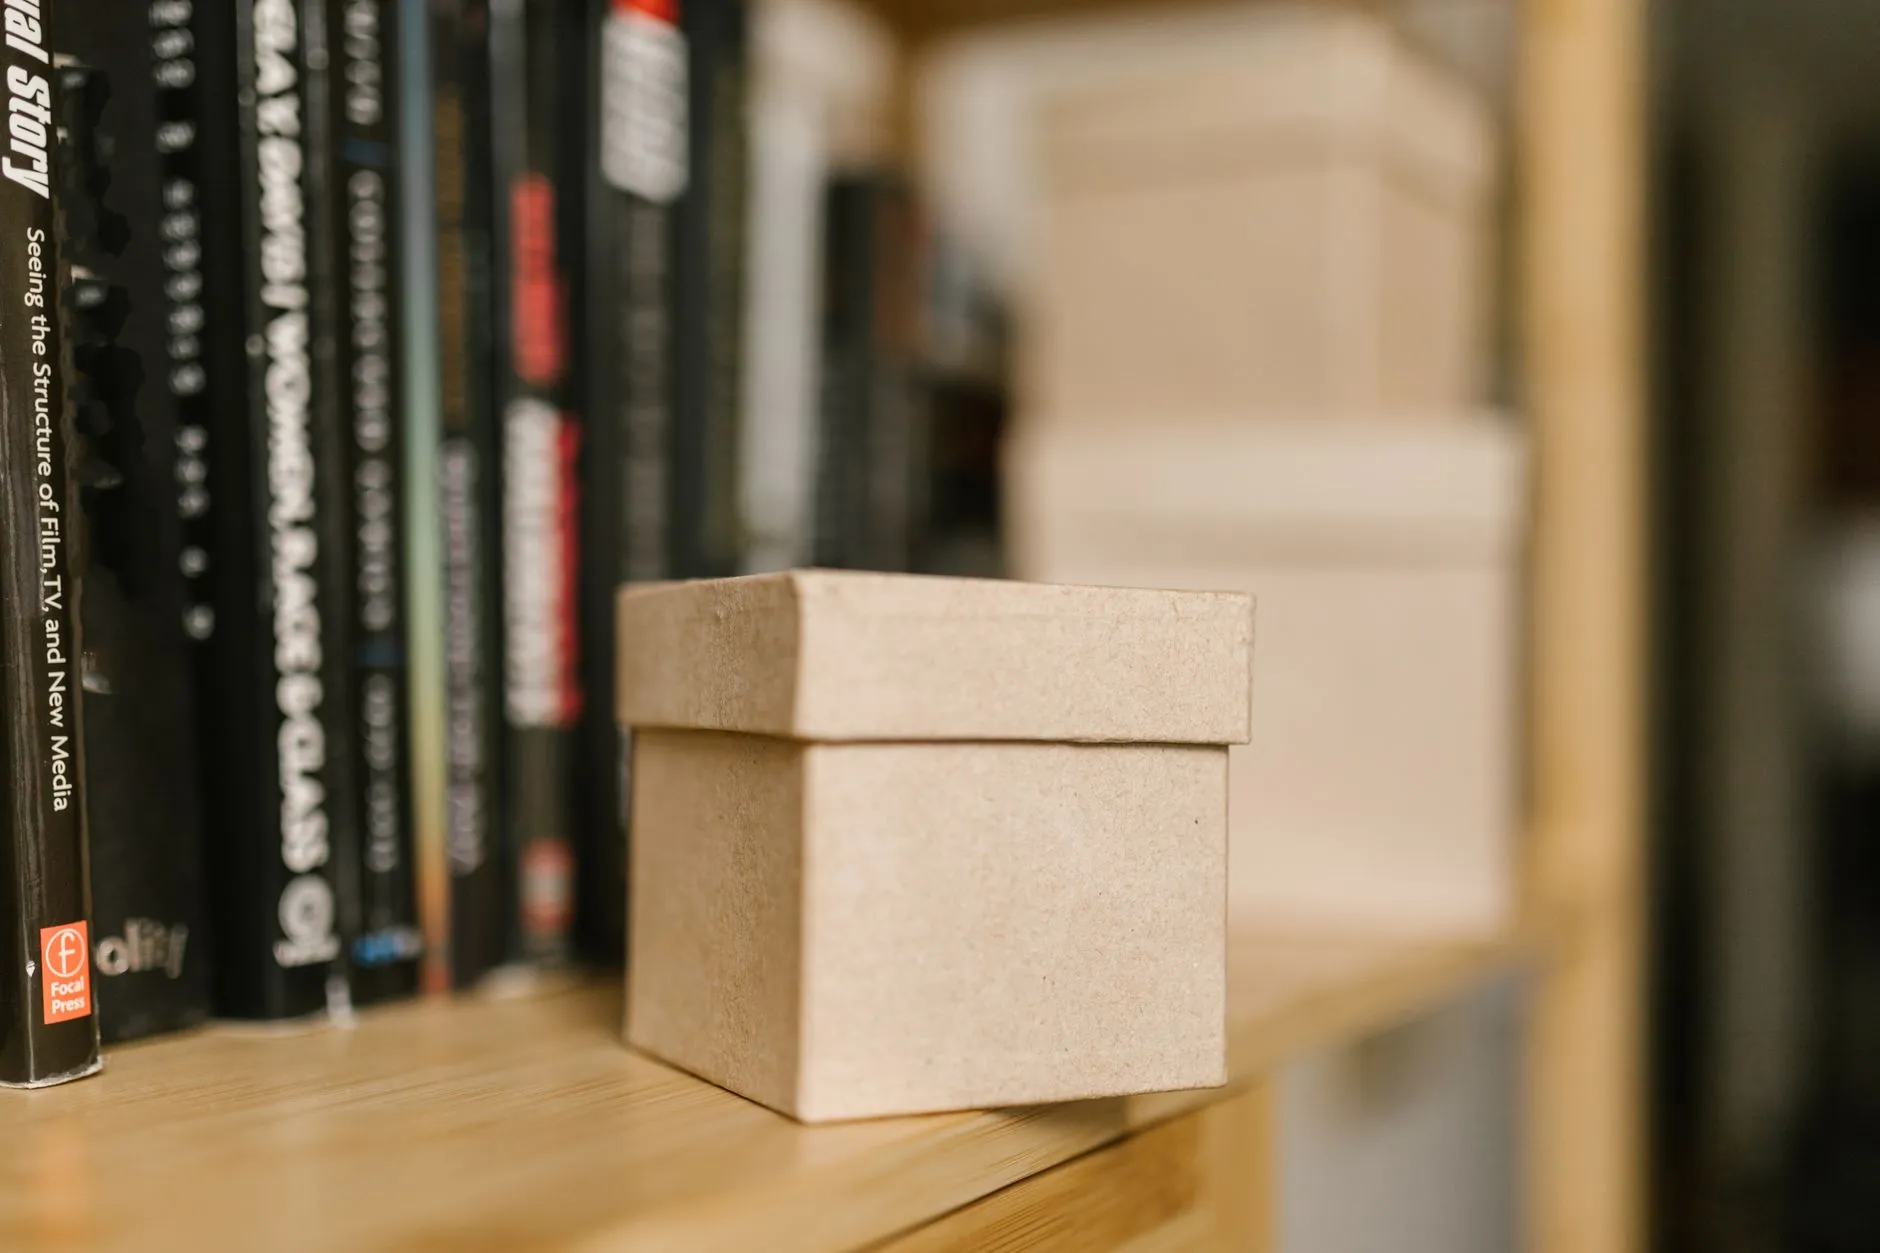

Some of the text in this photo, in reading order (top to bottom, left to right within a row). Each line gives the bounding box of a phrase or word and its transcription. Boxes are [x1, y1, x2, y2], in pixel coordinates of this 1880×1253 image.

[2, 66, 52, 199] Story
[24, 227, 47, 308] Seeing
[30, 314, 51, 356] the
[32, 362, 54, 477] Structure
[38, 483, 59, 512] of
[45, 619, 66, 664] and
[48, 671, 67, 727] New
[51, 736, 74, 812] Media
[50, 975, 85, 998] Focal
[51, 996, 86, 1015] Press
